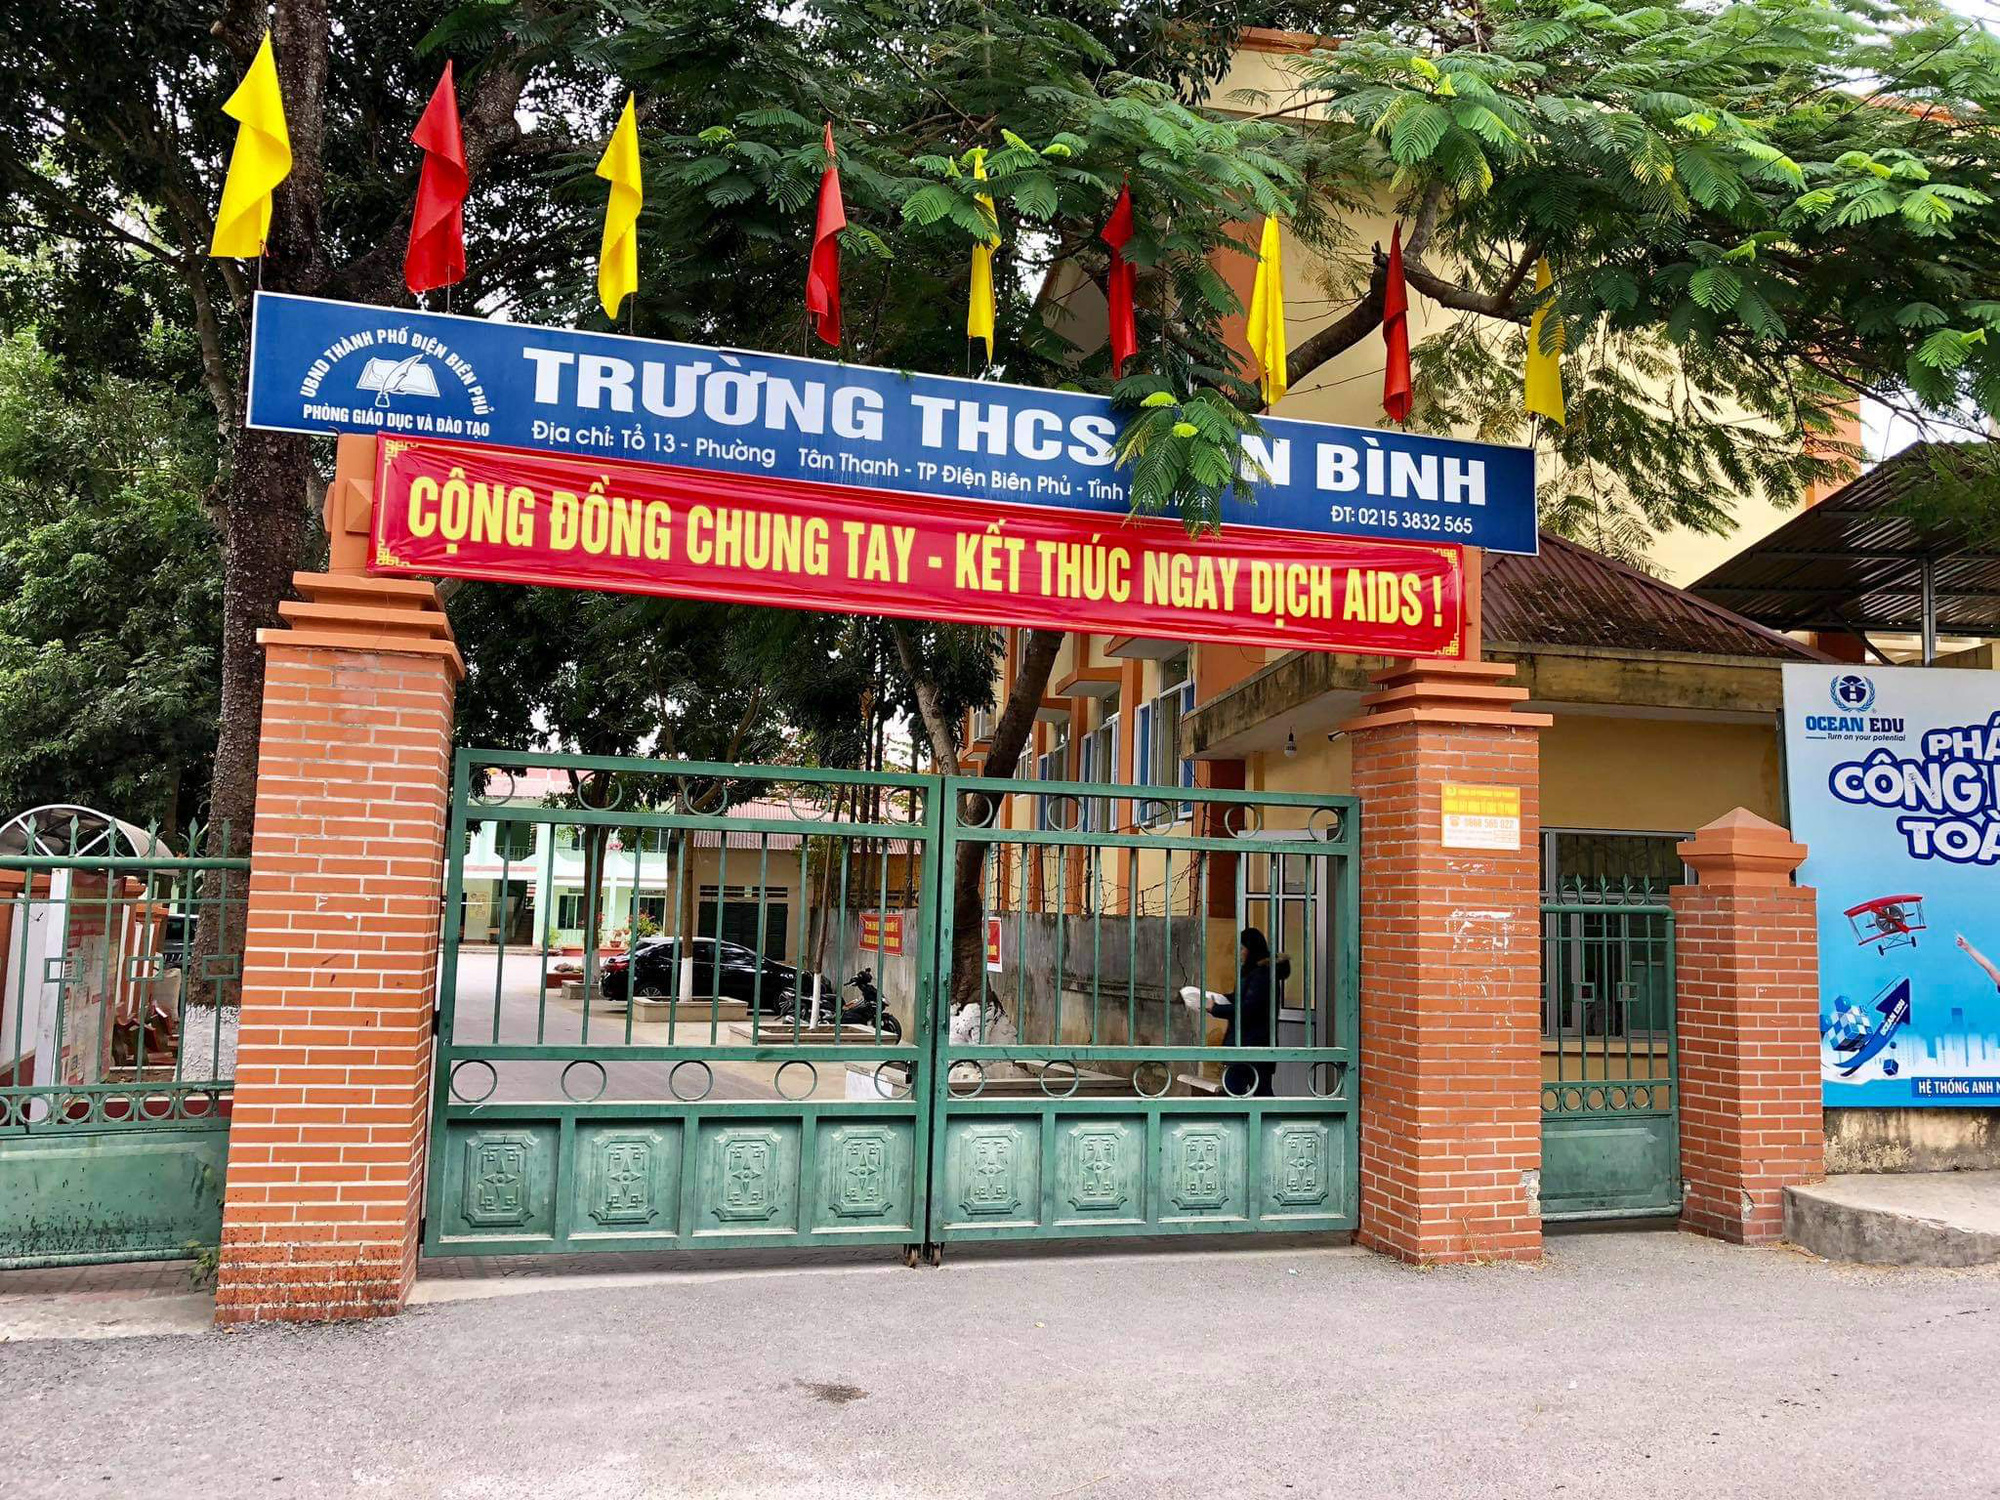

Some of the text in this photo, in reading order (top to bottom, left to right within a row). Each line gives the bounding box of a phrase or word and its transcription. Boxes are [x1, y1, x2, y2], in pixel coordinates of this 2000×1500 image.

[300, 326, 495, 416] UBND THÀNH PHỐ ĐIỆN BIÊN PHỦ
[303, 402, 490, 439] PHÒNG GIÁO DỤC VÀ ĐÀO TẠO
[523, 346, 885, 442] TRƯỜNG
[910, 394, 1117, 467] THCS
[1316, 436, 1486, 506] BÌNH
[531, 420, 570, 446] Địa
[576, 424, 614, 447] chỉ:
[622, 423, 646, 451] Tổ
[653, 432, 676, 453] 13
[695, 438, 776, 469] Phường
[799, 447, 834, 471] Tân
[839, 452, 899, 478] Thanh
[917, 462, 938, 481] TP
[942, 463, 986, 490] Điện
[991, 471, 1031, 493] Biên
[1037, 474, 1071, 496] Phủ
[1088, 479, 1123, 501] Tỉnh
[1331, 505, 1473, 534] ĐT: 0215 3832 565
[407, 466, 1443, 629] CỘNG ĐỒNG CHUNG TAY - KẾT THÚC NGAY DỊCH AIDS !
[1805, 715, 1905, 733] OCEAN EDU
[1827, 732, 1843, 740] Turn
[1855, 734, 1871, 742] your
[1872, 734, 1906, 742] potential
[1834, 752, 1983, 815] CÔNG
[1918, 1079, 1932, 1097] HỆ
[1934, 1077, 1969, 1094] THỐNG
[1971, 1080, 1994, 1094] ANH
